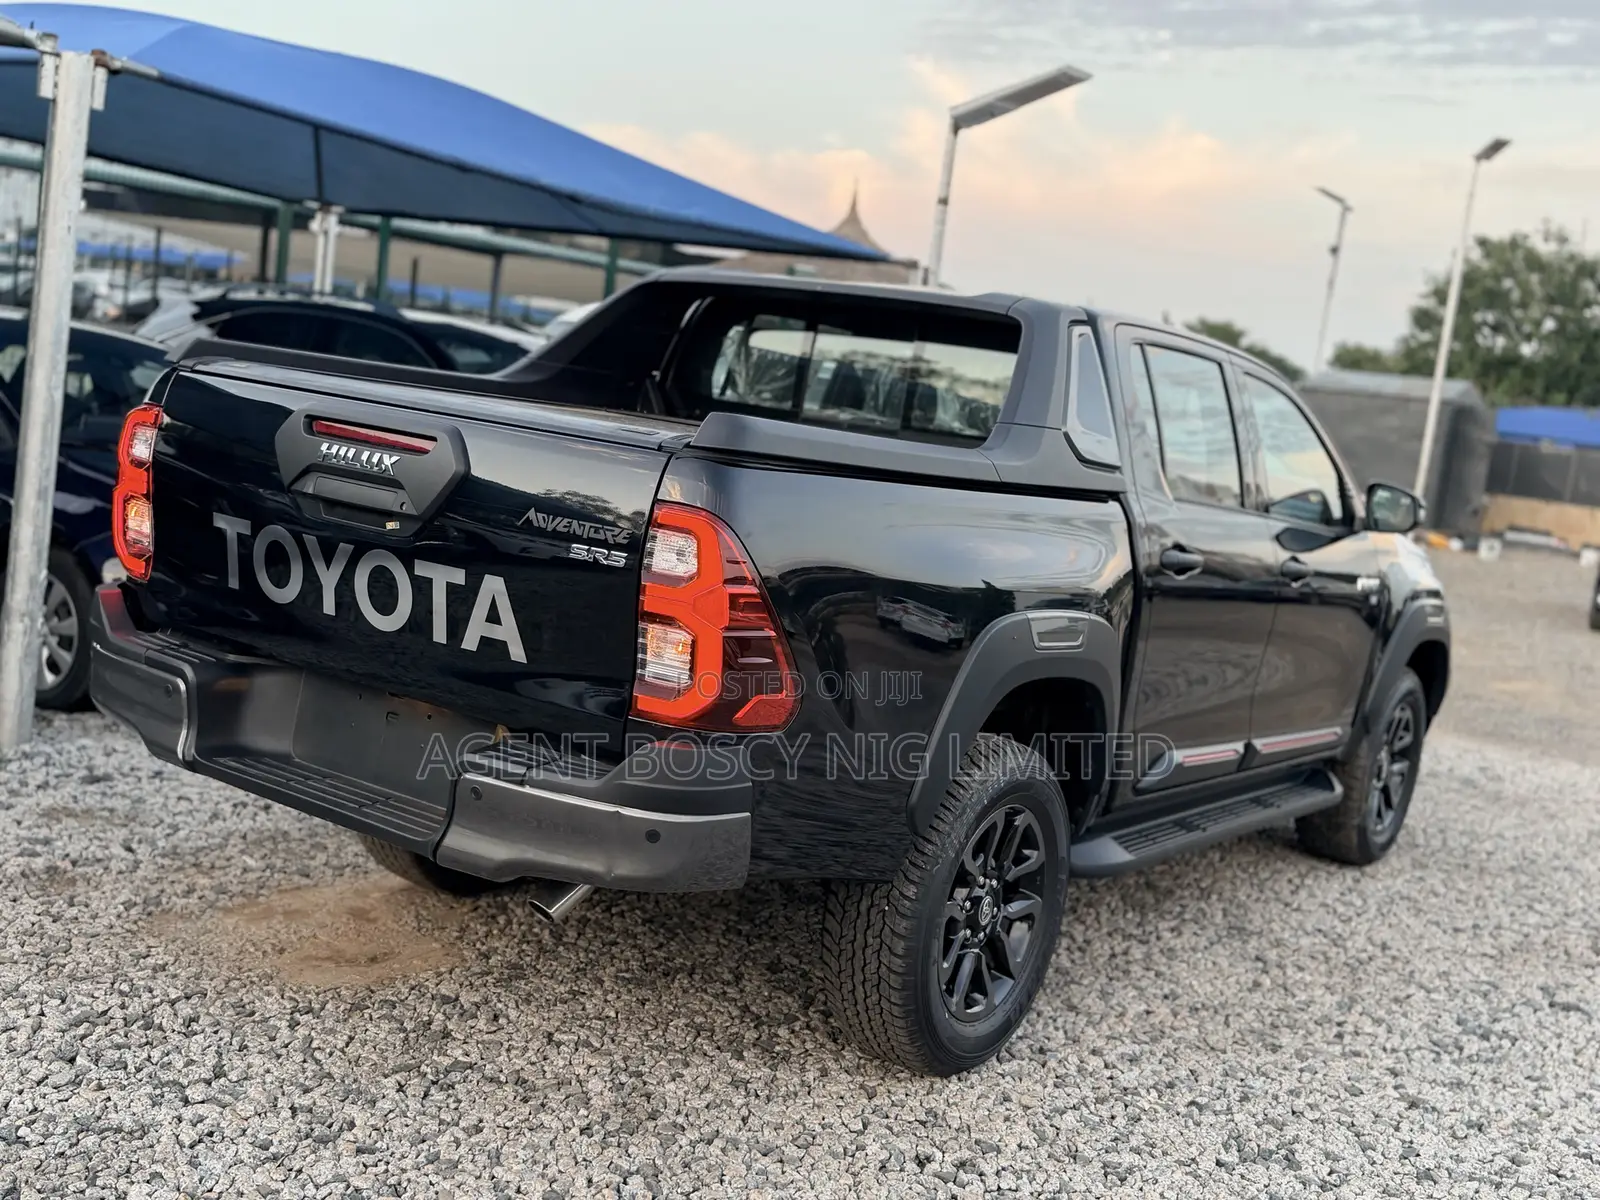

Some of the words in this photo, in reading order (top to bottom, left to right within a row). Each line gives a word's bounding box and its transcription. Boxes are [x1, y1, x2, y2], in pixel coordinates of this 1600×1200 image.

[318, 442, 401, 476] HILUX
[516, 507, 634, 545] ADVENTURE
[568, 543, 629, 568] SR5
[212, 511, 528, 665] TOYOTA
